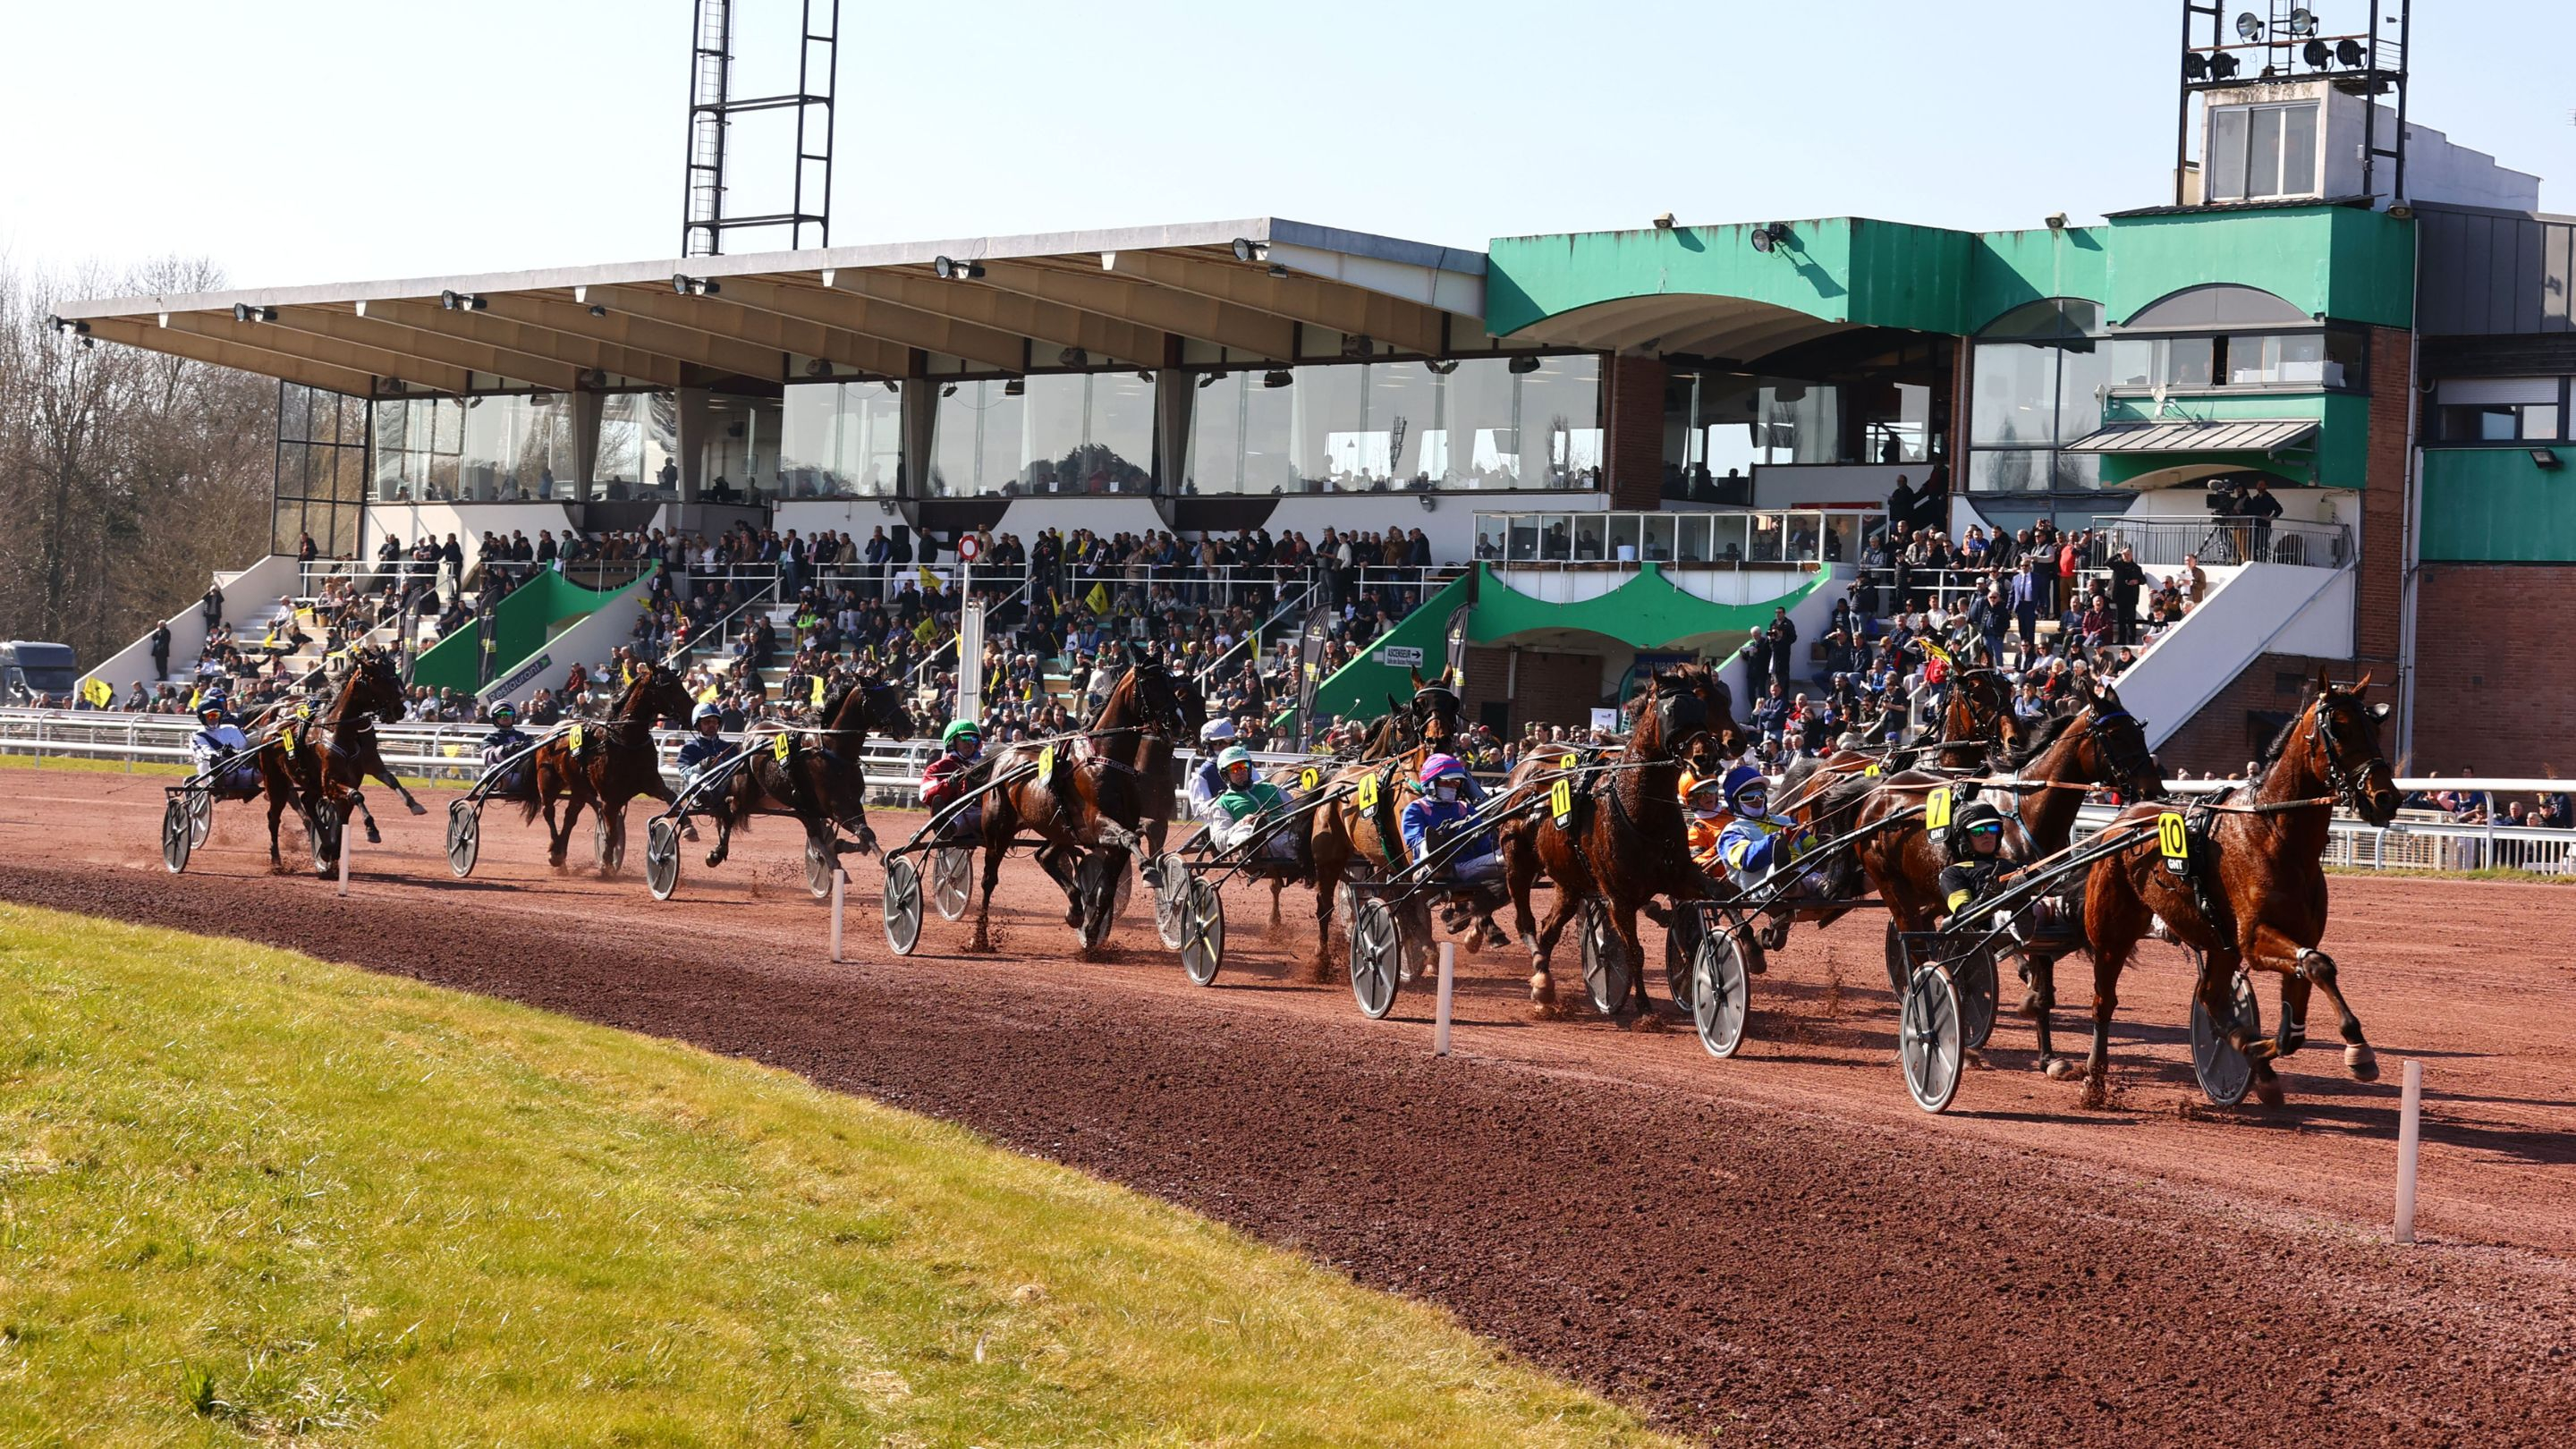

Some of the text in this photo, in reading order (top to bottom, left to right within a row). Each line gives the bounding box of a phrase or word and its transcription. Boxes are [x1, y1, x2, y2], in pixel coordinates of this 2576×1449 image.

[1387, 648, 1411, 658] ASCENSEUR
[488, 662, 541, 700] Restaurant
[283, 730, 293, 750] 12
[570, 726, 580, 748] 16
[775, 733, 787, 758] 14
[1043, 749, 1049, 772] 3
[1363, 777, 1372, 803] 4
[1554, 782, 1567, 813] 11
[1363, 806, 1375, 818] GNT
[1556, 814, 1568, 826] GNT
[1933, 792, 1944, 826] 7
[1930, 827, 1945, 840] GNT
[2160, 818, 2183, 854] 10
[2167, 858, 2183, 870] GNT
